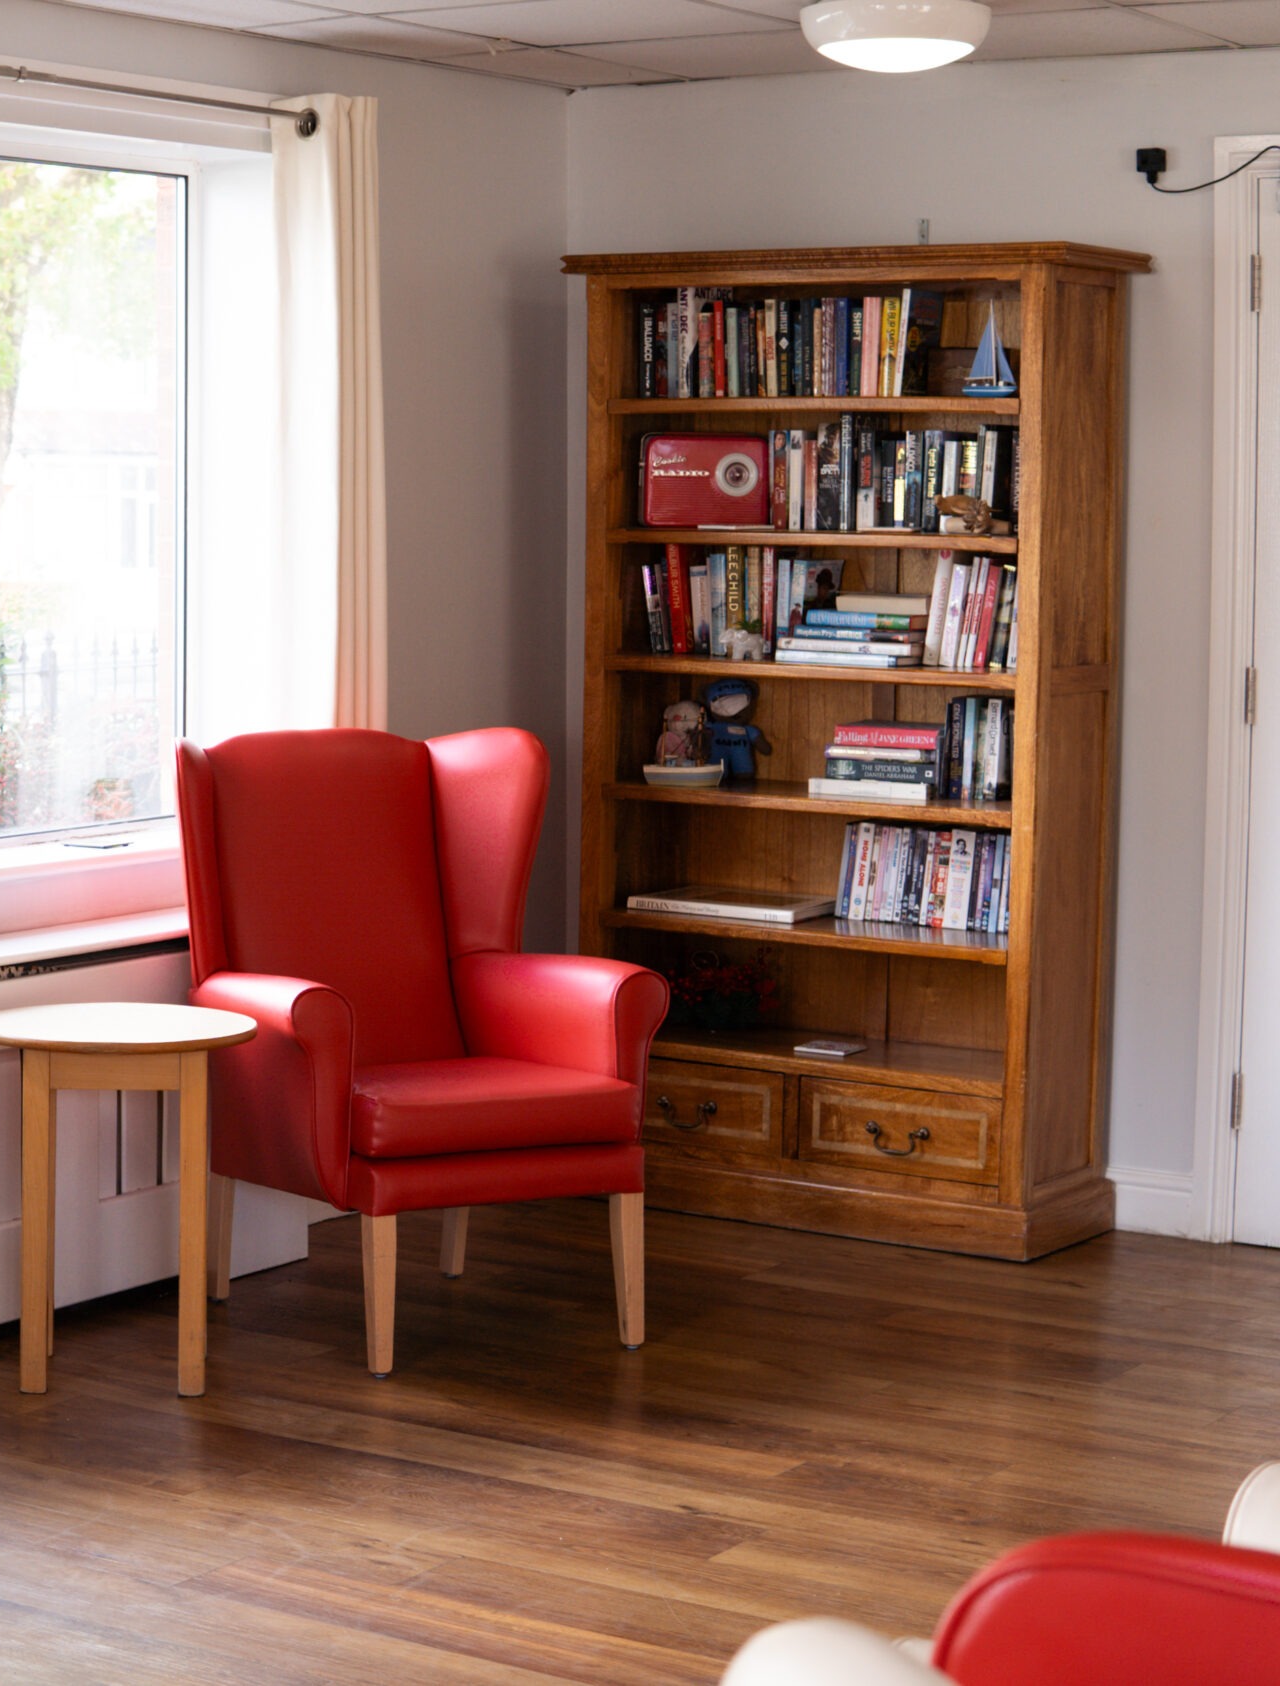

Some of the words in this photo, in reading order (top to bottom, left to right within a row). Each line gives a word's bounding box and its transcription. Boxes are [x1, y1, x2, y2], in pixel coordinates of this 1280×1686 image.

[680, 287, 688, 307] ANT
[680, 315, 688, 334] DEC
[853, 312, 862, 342] SHIFT
[644, 320, 653, 362] BALDACCI
[906, 434, 916, 473] BALDACCI
[728, 546, 738, 570] LEE
[672, 579, 681, 609] SMITH
[728, 573, 738, 611] CHILD
[991, 702, 999, 729] Bernard
[878, 734, 899, 744] JANE
[902, 766, 918, 774] WAR
[861, 840, 869, 861] HOME
[857, 863, 866, 887] ALONE
[636, 899, 670, 911] BRITAIN
